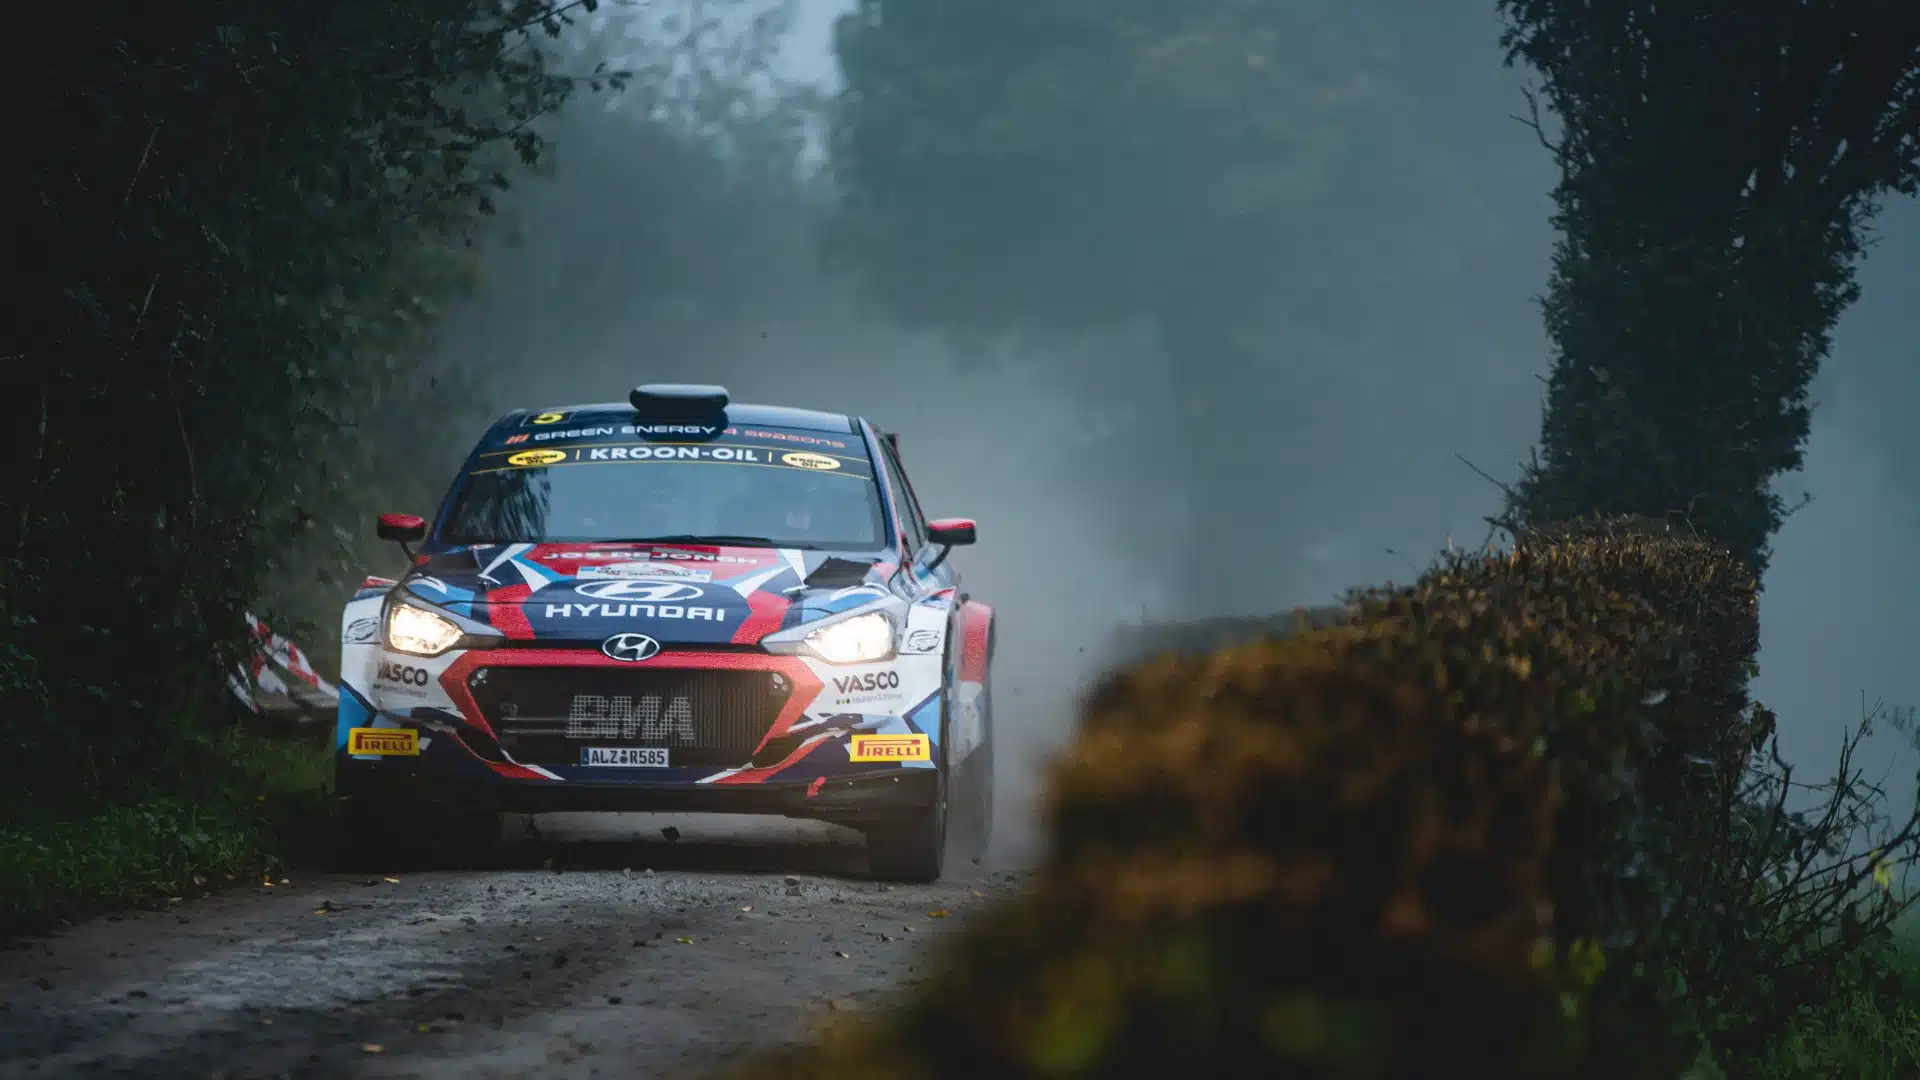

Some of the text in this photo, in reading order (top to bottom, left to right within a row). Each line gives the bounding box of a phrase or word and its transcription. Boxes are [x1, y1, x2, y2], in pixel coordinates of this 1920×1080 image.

[535, 427, 613, 440] GREEN
[621, 425, 716, 434] ENERGY
[590, 447, 758, 462] KROON-OIL
[545, 603, 726, 622] HYUNDAI
[832, 670, 900, 695] VASCO
[565, 694, 695, 740] BMA
[355, 732, 413, 751] PIRELLI
[856, 738, 921, 757] PIRELLI
